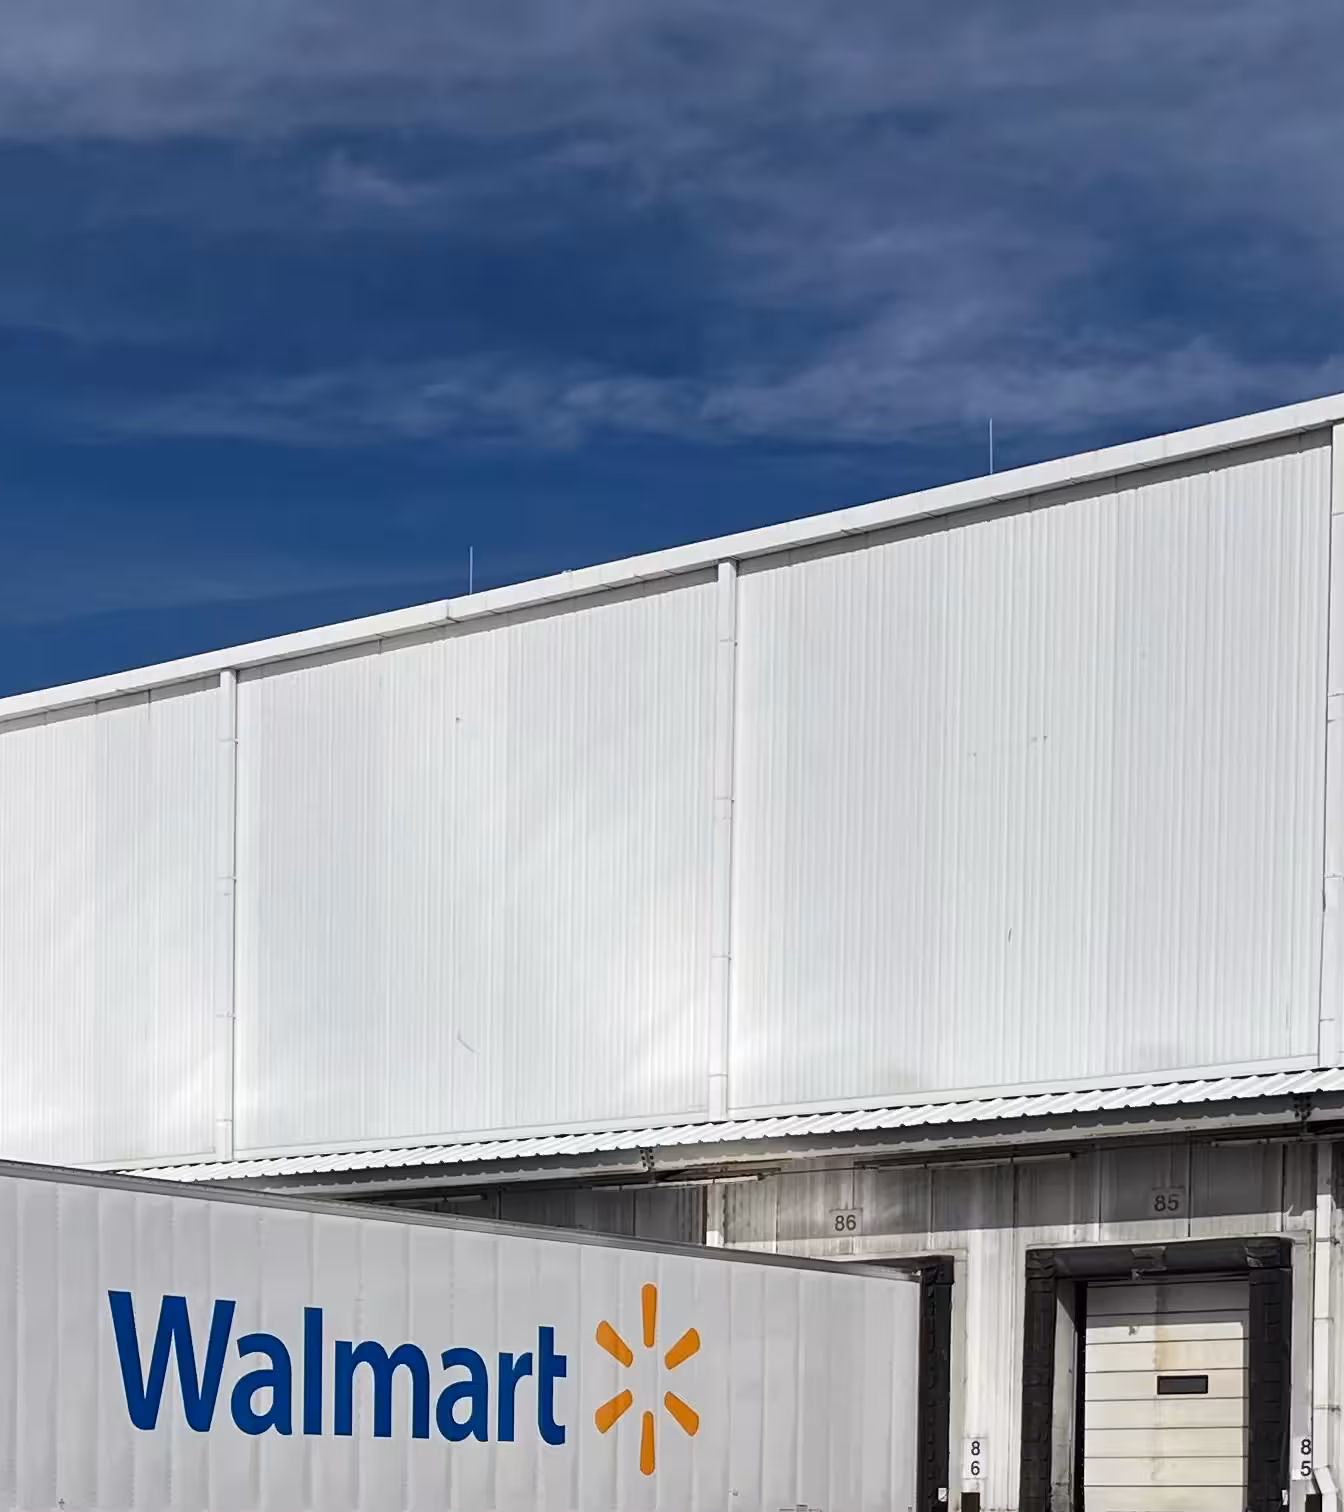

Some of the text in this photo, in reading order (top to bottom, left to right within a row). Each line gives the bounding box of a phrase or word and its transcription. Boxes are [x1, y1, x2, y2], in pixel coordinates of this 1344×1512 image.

[1154, 1193, 1180, 1212] 85
[834, 1214, 857, 1232] 86
[107, 1289, 568, 1447] Walmart
[970, 1440, 981, 1476] 86
[1300, 1438, 1312, 1477] 85
